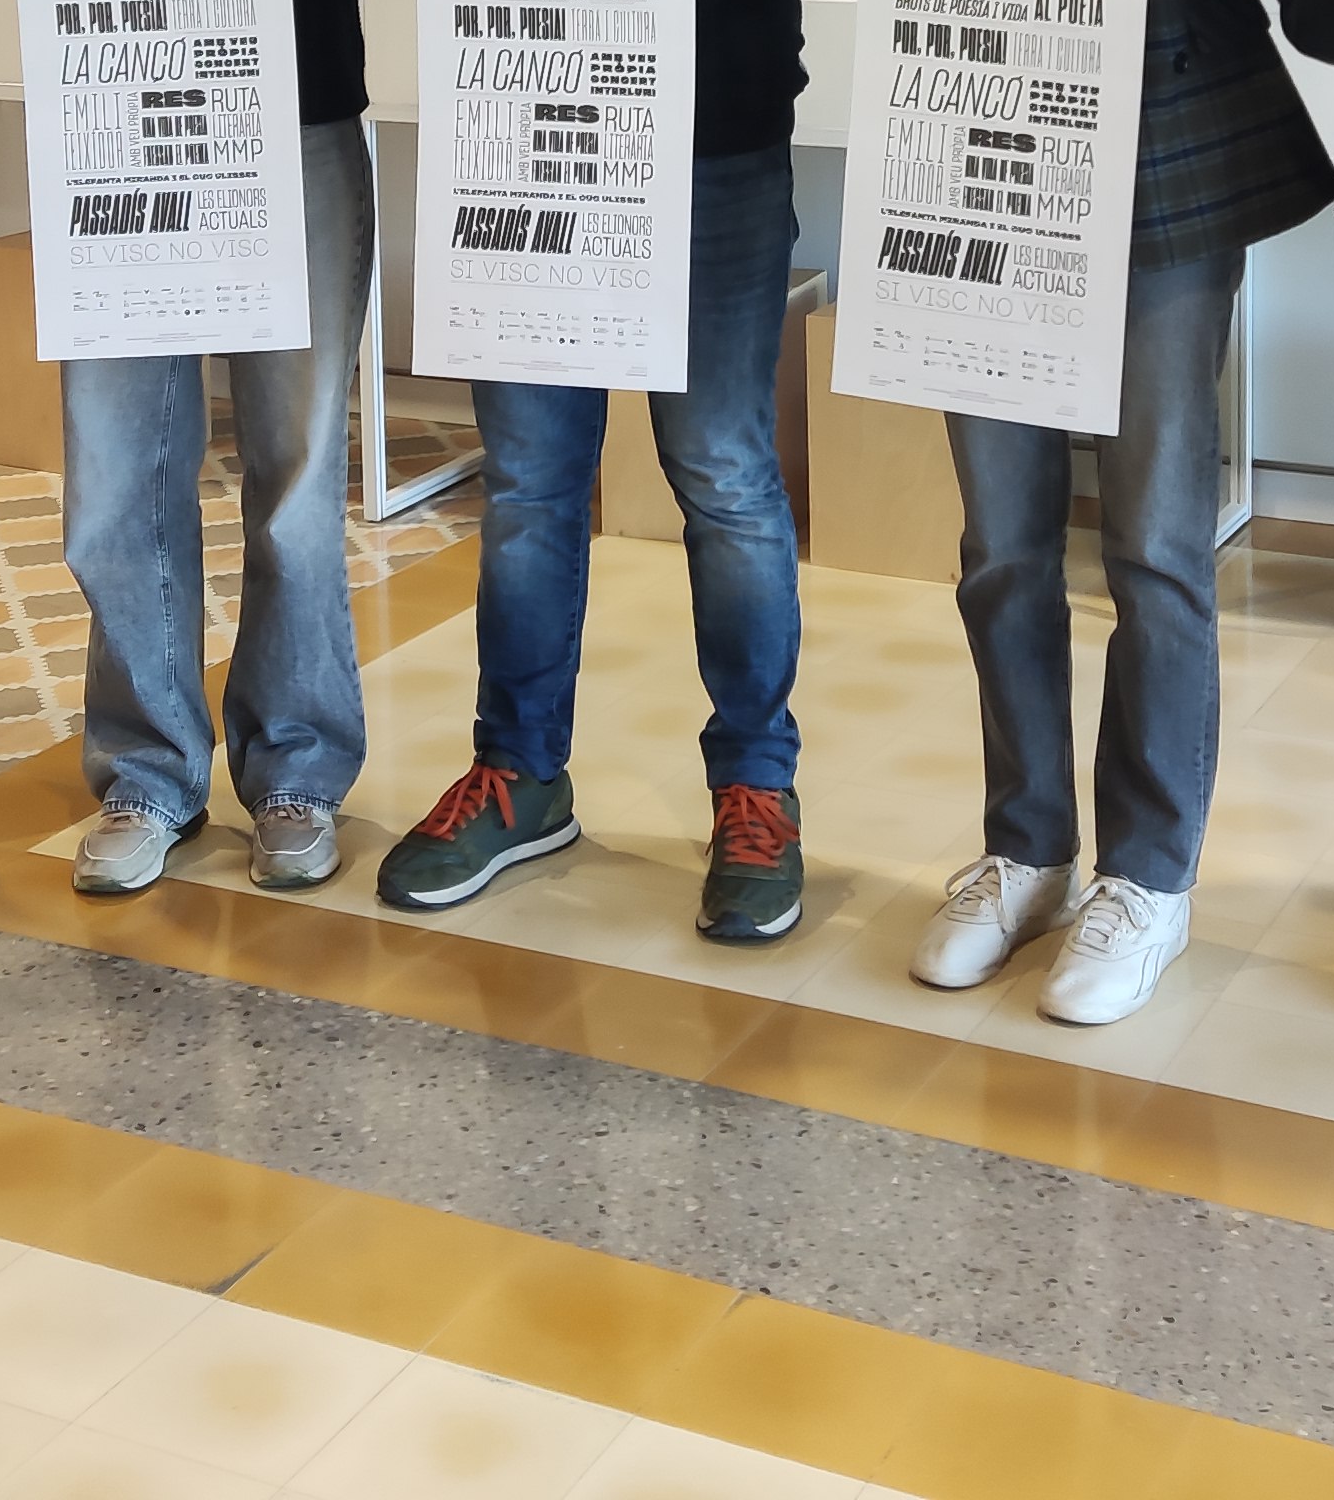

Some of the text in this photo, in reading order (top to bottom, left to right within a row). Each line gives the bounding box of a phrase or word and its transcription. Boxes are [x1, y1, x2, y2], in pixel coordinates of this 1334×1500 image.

[571, 8, 600, 41] TERRA
[614, 10, 655, 44] CULTURA
[141, 89, 206, 109] RES
[890, 65, 1023, 120] LA CANÇÓ
[455, 99, 513, 141] EMILI
[605, 106, 654, 134] RUTA
[968, 128, 1036, 153] RES
[603, 160, 653, 188] MMP
[198, 208, 267, 230] ACTUALS
[878, 227, 1009, 285] PASSADÍS AVALL
[451, 260, 650, 289] SI VISC NO VISC
[1012, 267, 1087, 297] ACTUALS
